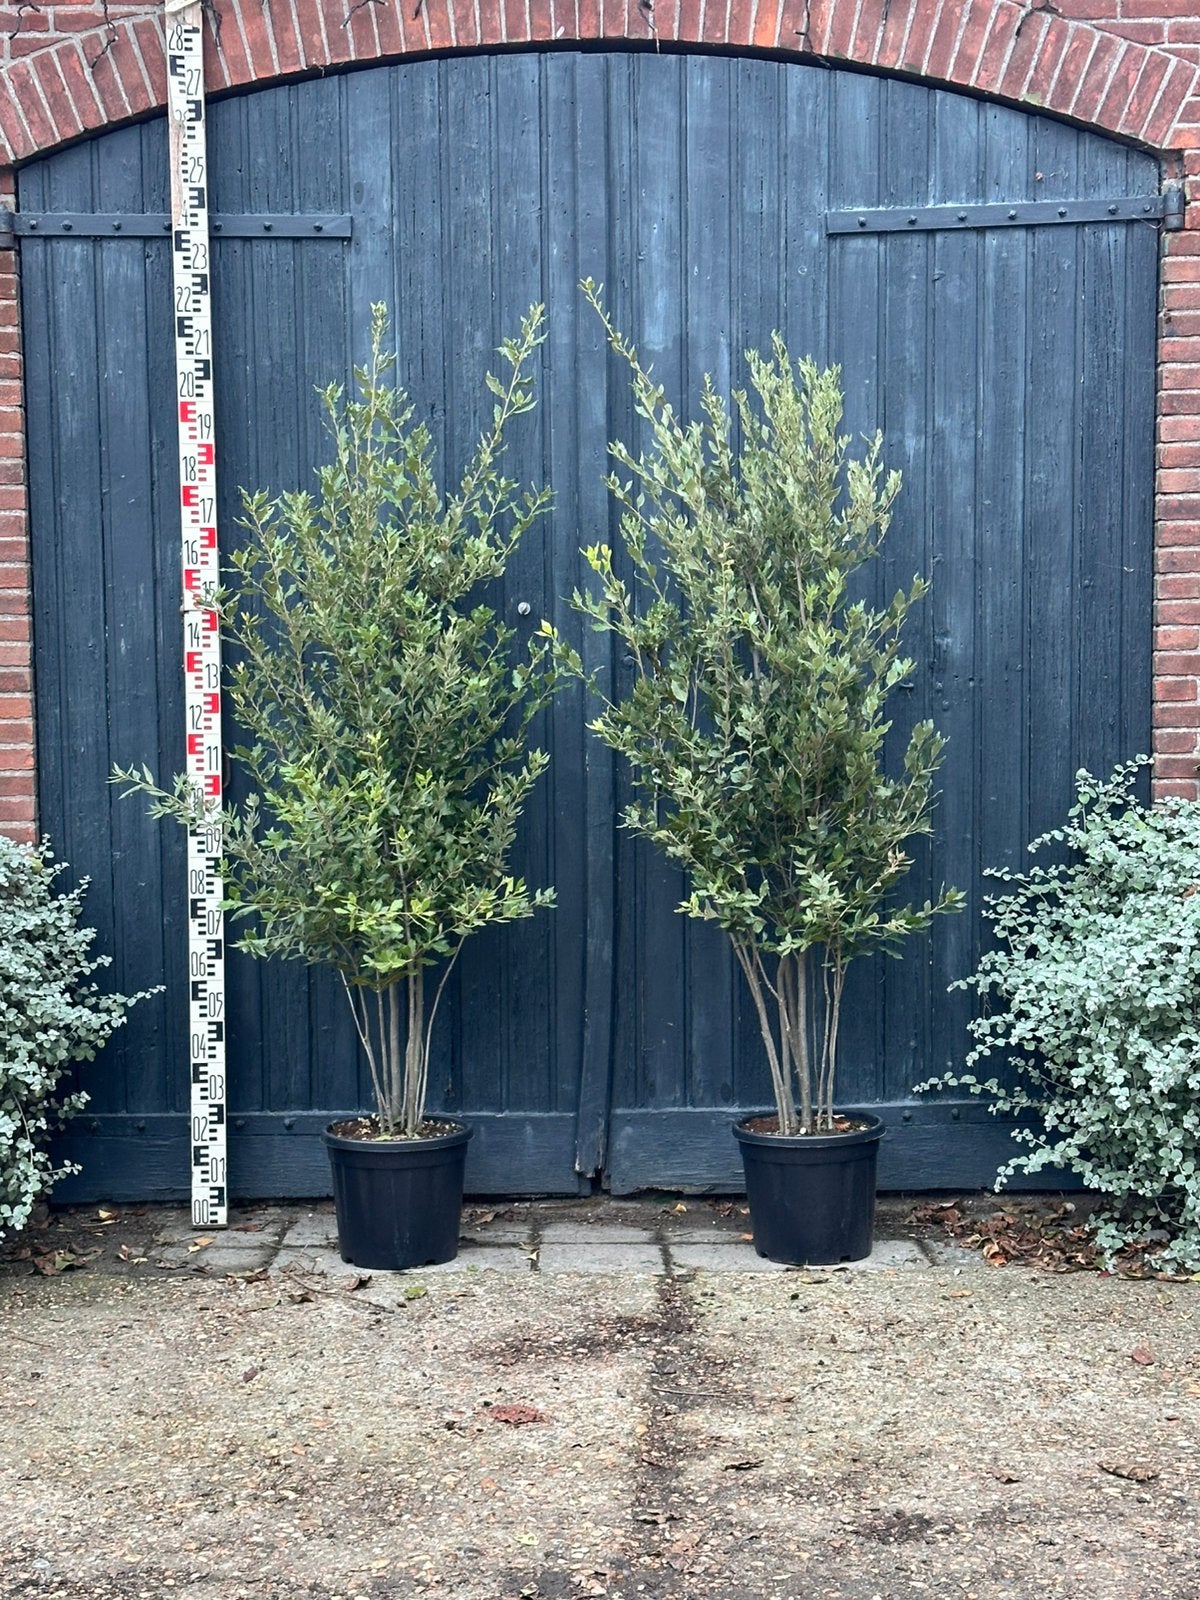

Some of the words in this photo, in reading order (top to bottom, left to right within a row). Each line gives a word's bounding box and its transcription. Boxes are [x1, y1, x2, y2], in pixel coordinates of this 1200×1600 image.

[169, 25, 183, 50] 28
[186, 69, 201, 95] 27
[189, 156, 204, 183] 25
[192, 243, 207, 270] 23
[176, 286, 191, 312] 22
[195, 329, 209, 355] 21
[180, 371, 194, 397] 20
[197, 413, 211, 439] 19
[182, 456, 196, 482] 18
[200, 498, 214, 523] 17
[184, 540, 198, 565] 16
[202, 581, 215, 602] 15
[188, 622, 200, 648] 14
[205, 663, 219, 689] 13
[189, 705, 202, 730] 12
[206, 746, 219, 771] 11
[206, 828, 221, 853] 09
[190, 869, 205, 895] 08
[207, 910, 222, 935] 07
[191, 951, 206, 977] 06
[209, 992, 223, 1017] 05
[192, 1033, 206, 1059] 04
[209, 1074, 224, 1100] 03
[193, 1116, 208, 1142] 02
[210, 1157, 225, 1183] 01
[193, 1199, 209, 1225] 00
